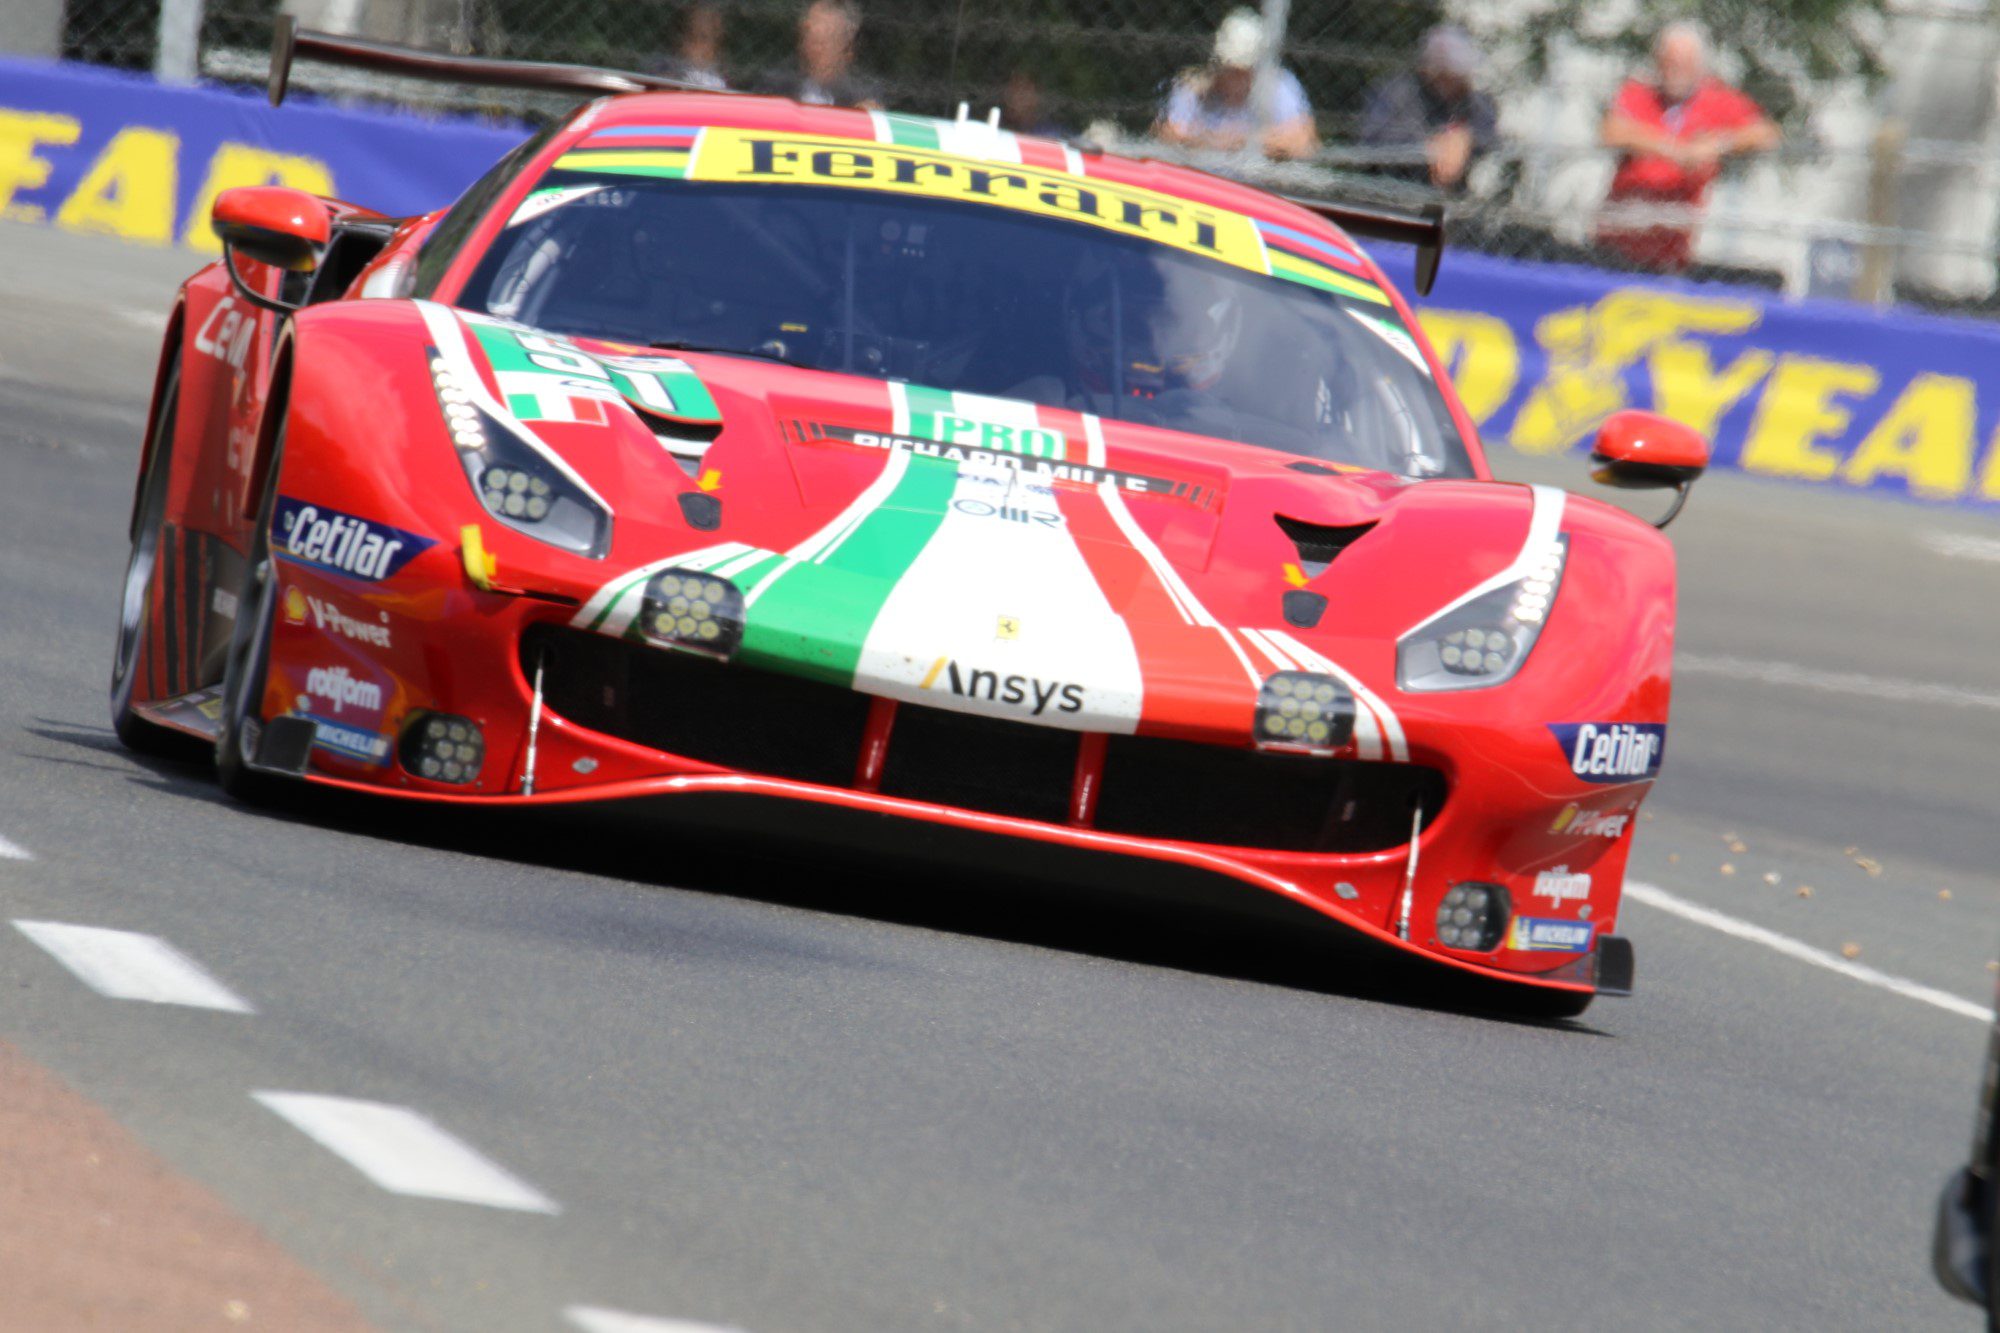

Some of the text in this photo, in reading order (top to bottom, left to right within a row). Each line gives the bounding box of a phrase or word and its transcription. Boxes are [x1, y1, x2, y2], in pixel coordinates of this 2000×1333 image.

[738, 138, 1223, 254] Ferrari
[942, 416, 1058, 460] PRO
[286, 505, 403, 581] Cetilar
[307, 595, 392, 648] V-Power
[919, 656, 1086, 716] Ansys
[1572, 723, 1656, 775] Cetilar
